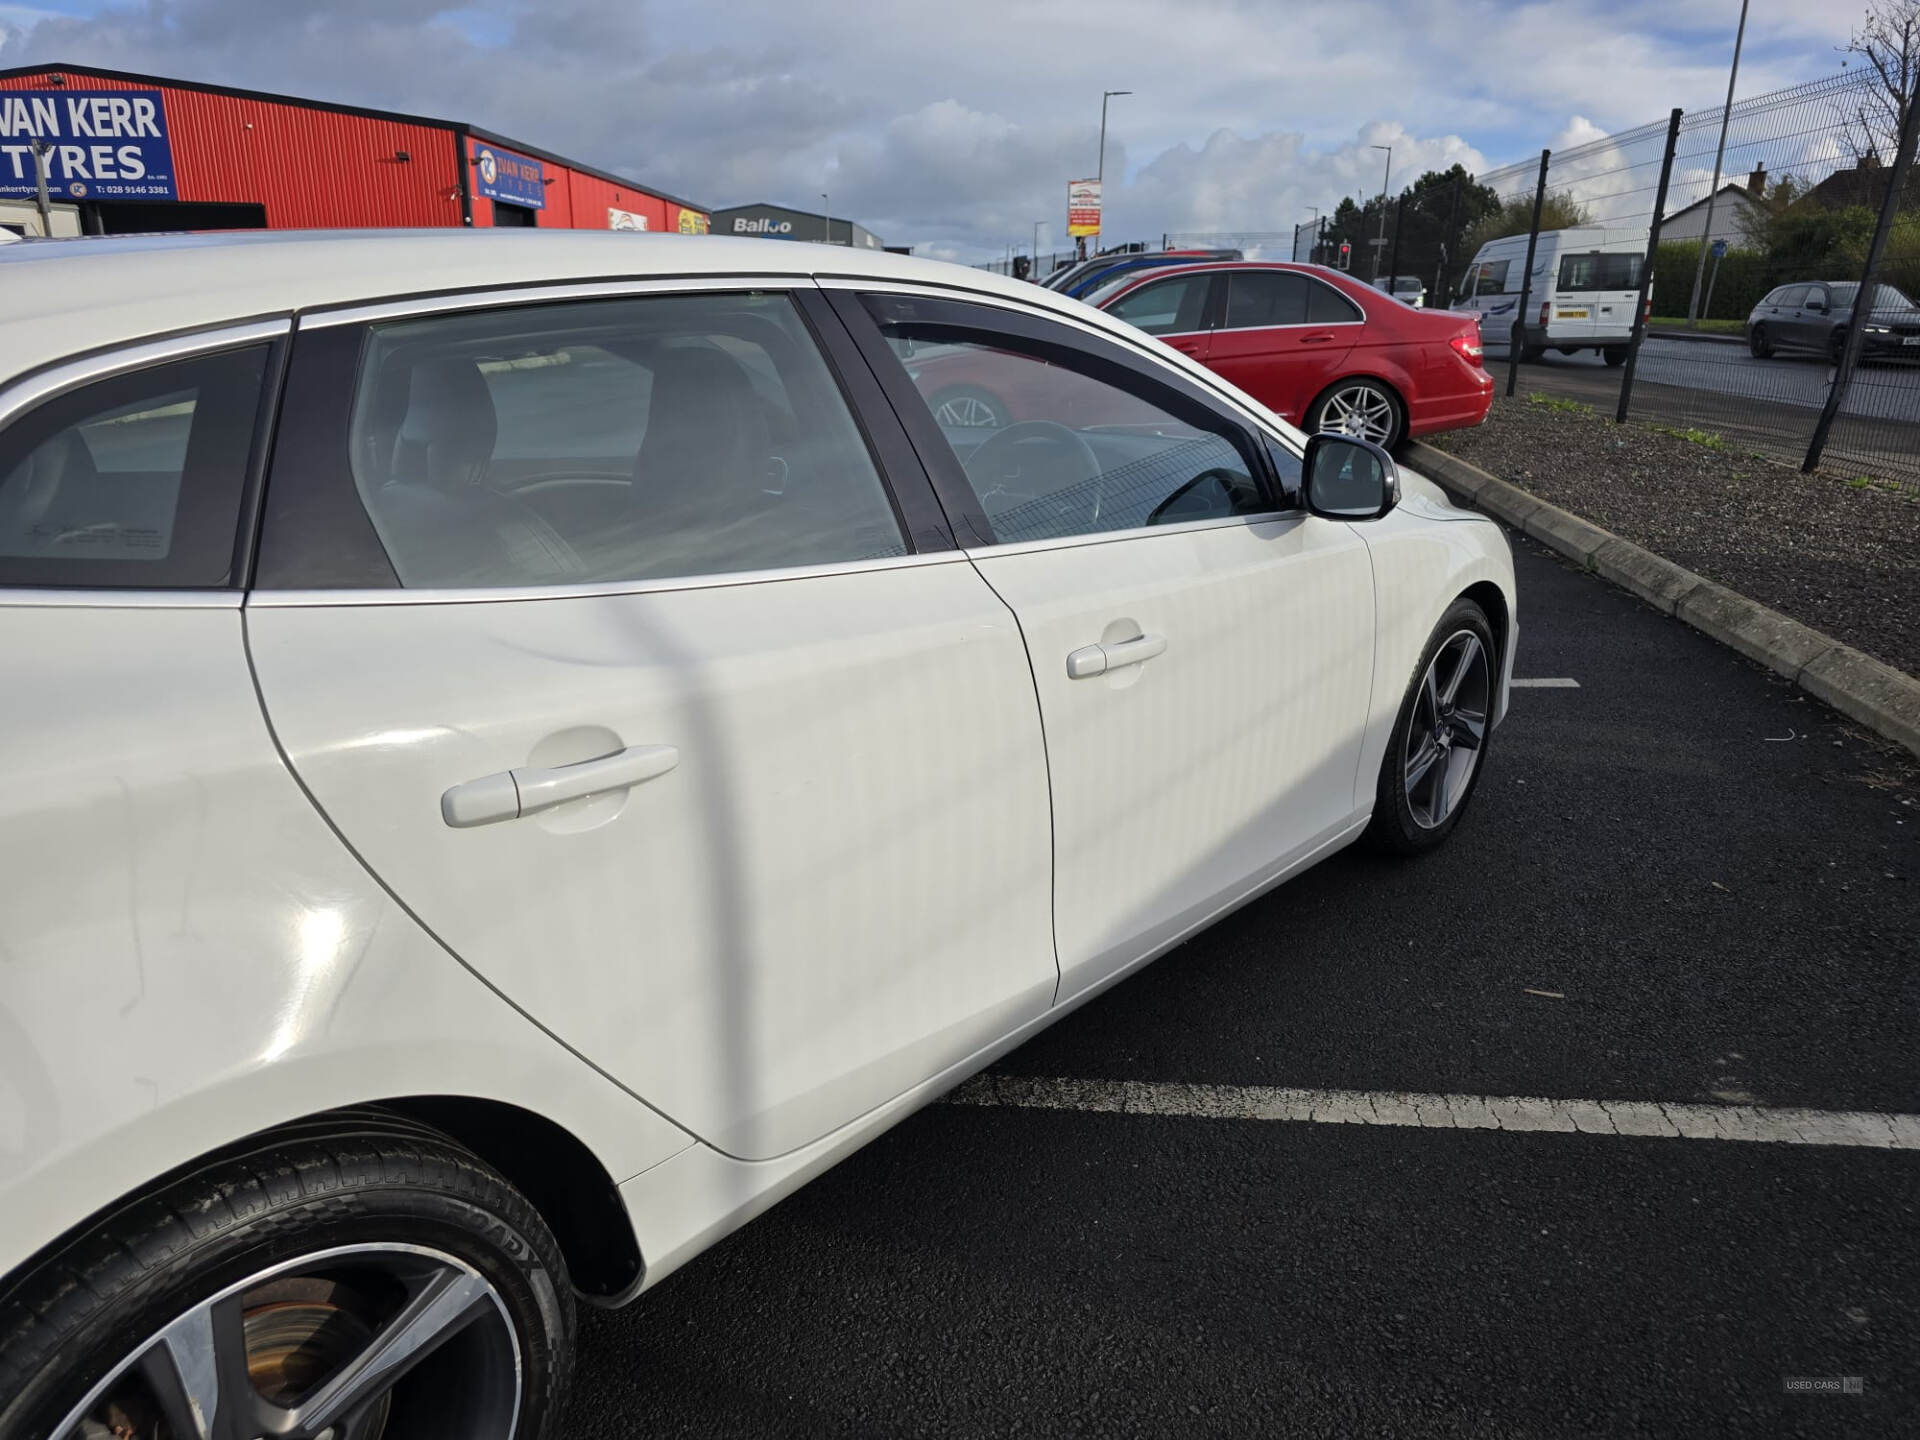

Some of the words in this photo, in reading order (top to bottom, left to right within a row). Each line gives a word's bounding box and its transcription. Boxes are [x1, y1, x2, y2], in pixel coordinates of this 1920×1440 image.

[67, 98, 162, 137] KERR
[1, 145, 146, 180] TYRES
[106, 186, 124, 194] 028
[125, 186, 147, 194] 9146
[148, 186, 169, 194] 3381
[733, 217, 792, 233] Balloo
